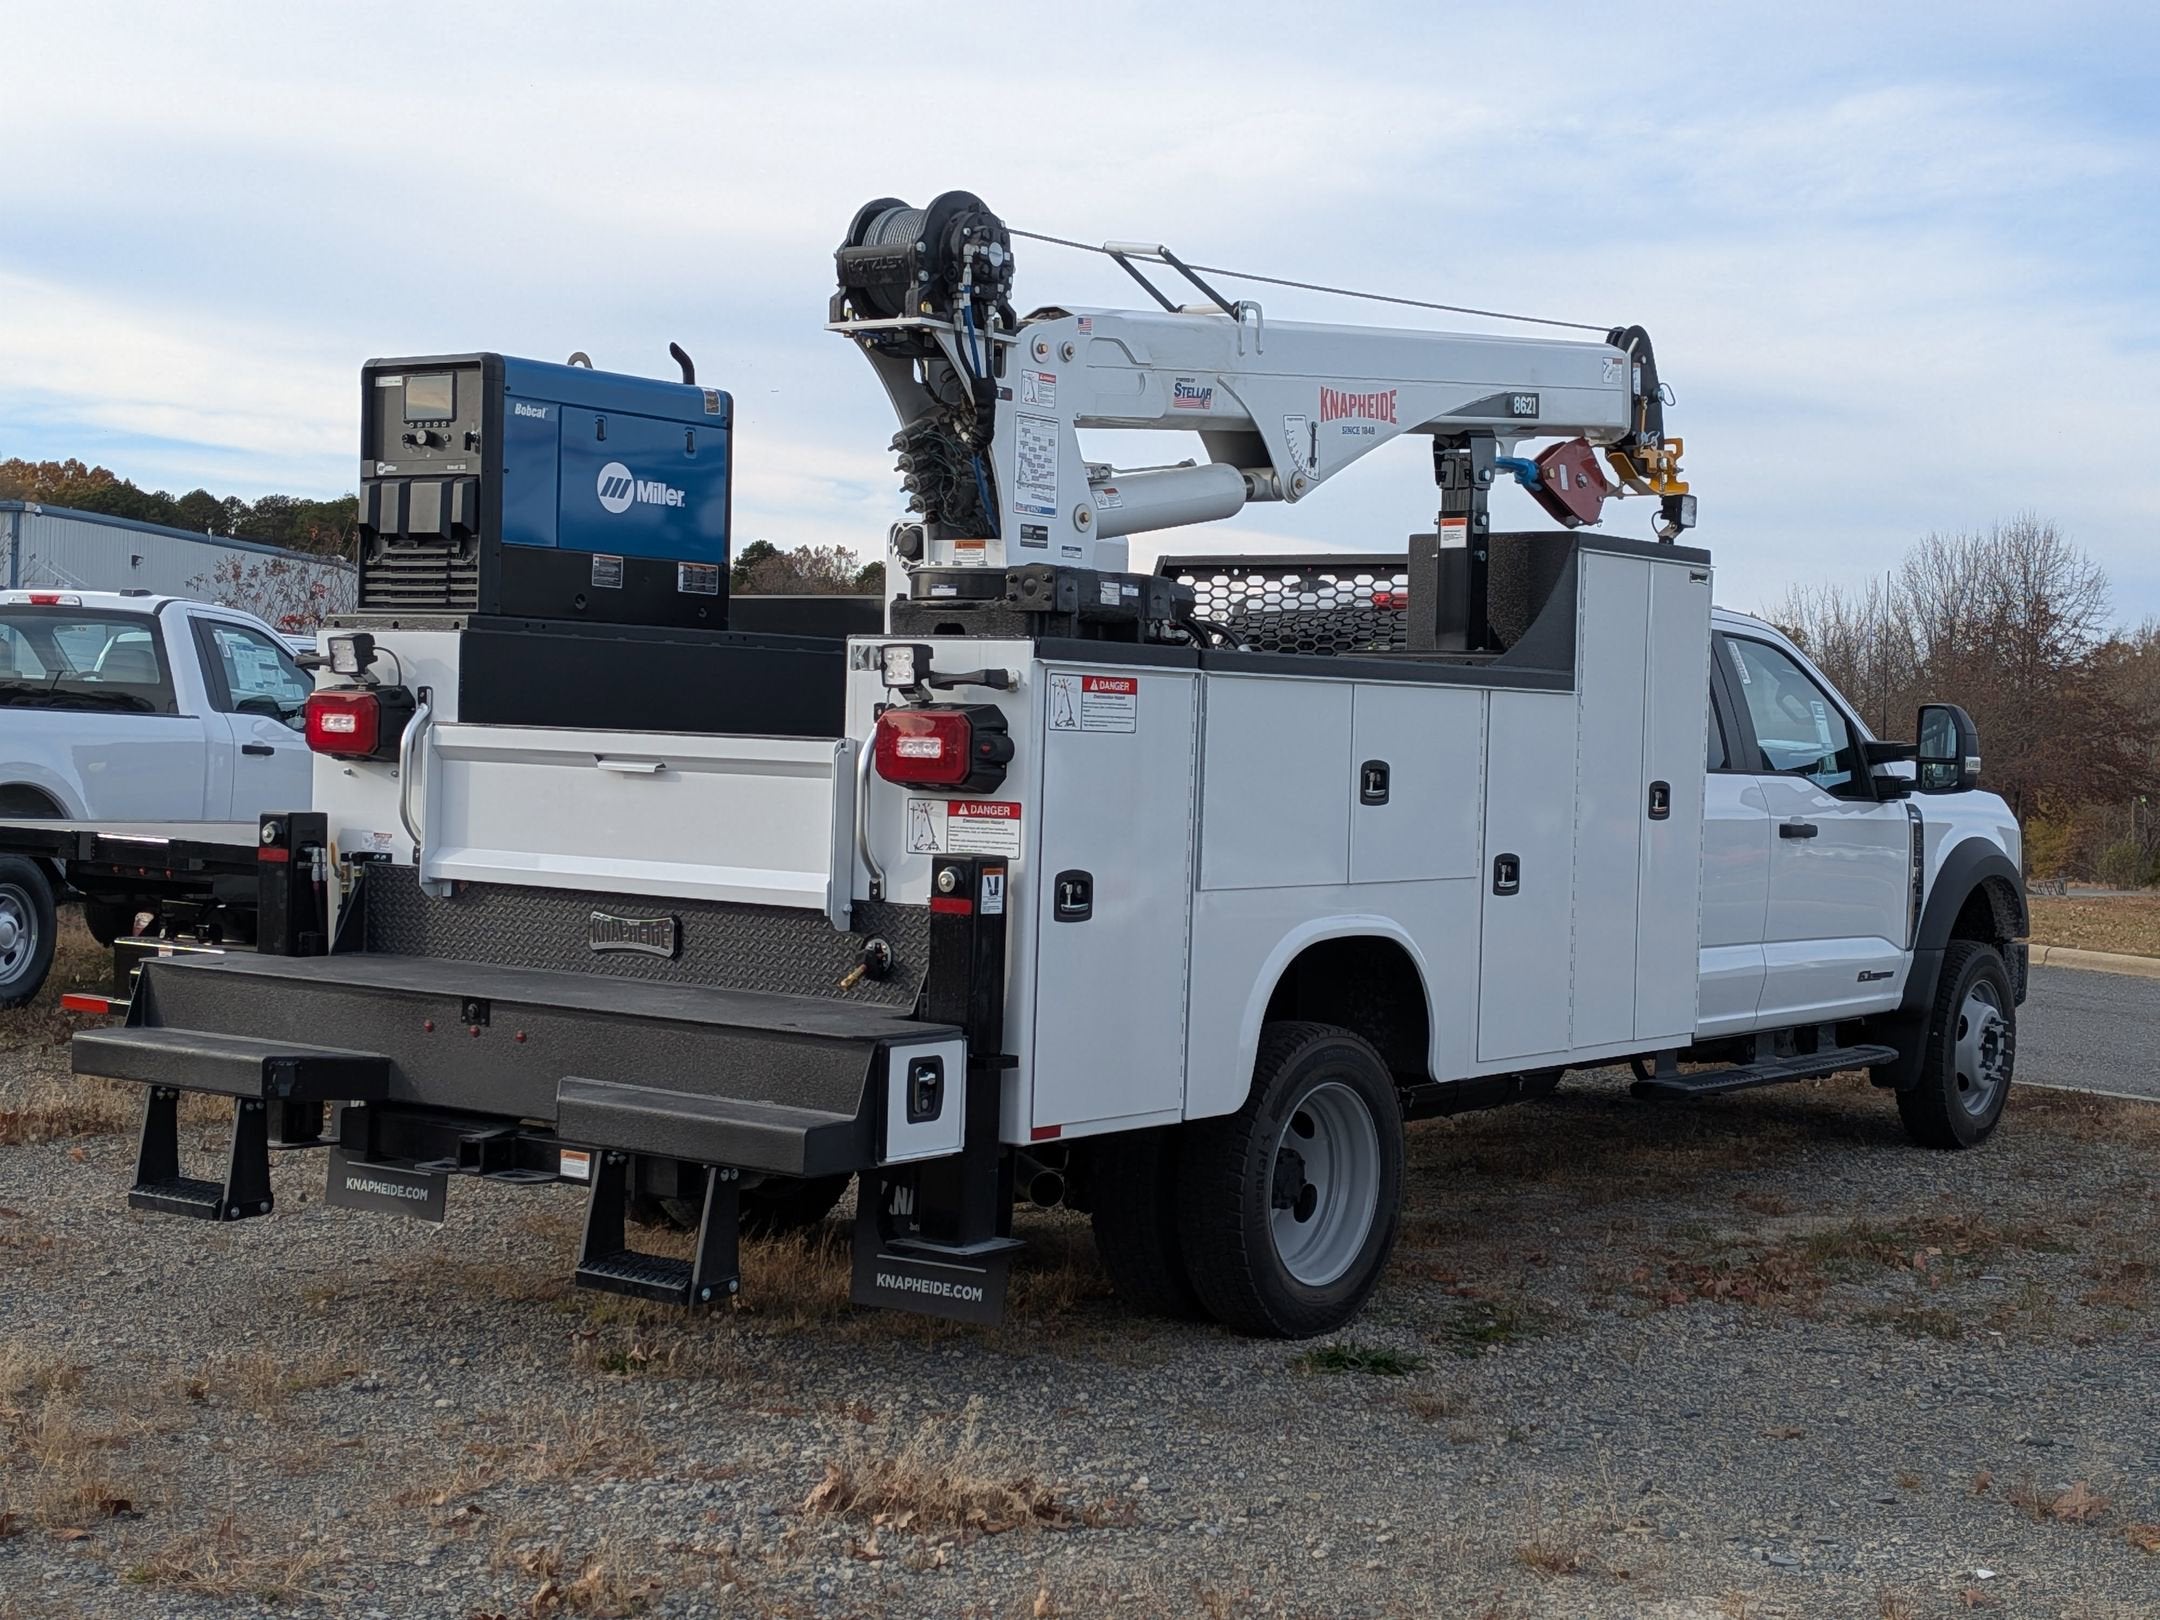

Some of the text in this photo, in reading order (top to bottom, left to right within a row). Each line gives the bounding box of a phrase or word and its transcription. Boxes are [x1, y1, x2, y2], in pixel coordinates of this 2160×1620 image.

[1174, 382, 1212, 400] STELLAR
[514, 403, 546, 419] Bobcat
[1320, 386, 1397, 425] KNAPHEIDE
[1513, 396, 1537, 415] 8621
[1341, 425, 1376, 435] SINCE 1848
[636, 480, 685, 507] Miller
[1099, 681, 1130, 691] DANGER
[970, 805, 1010, 816] DANGER
[345, 1176, 429, 1201] KNAPHEIDE.COM
[876, 1272, 983, 1302] KNAPHEIDE.COM
